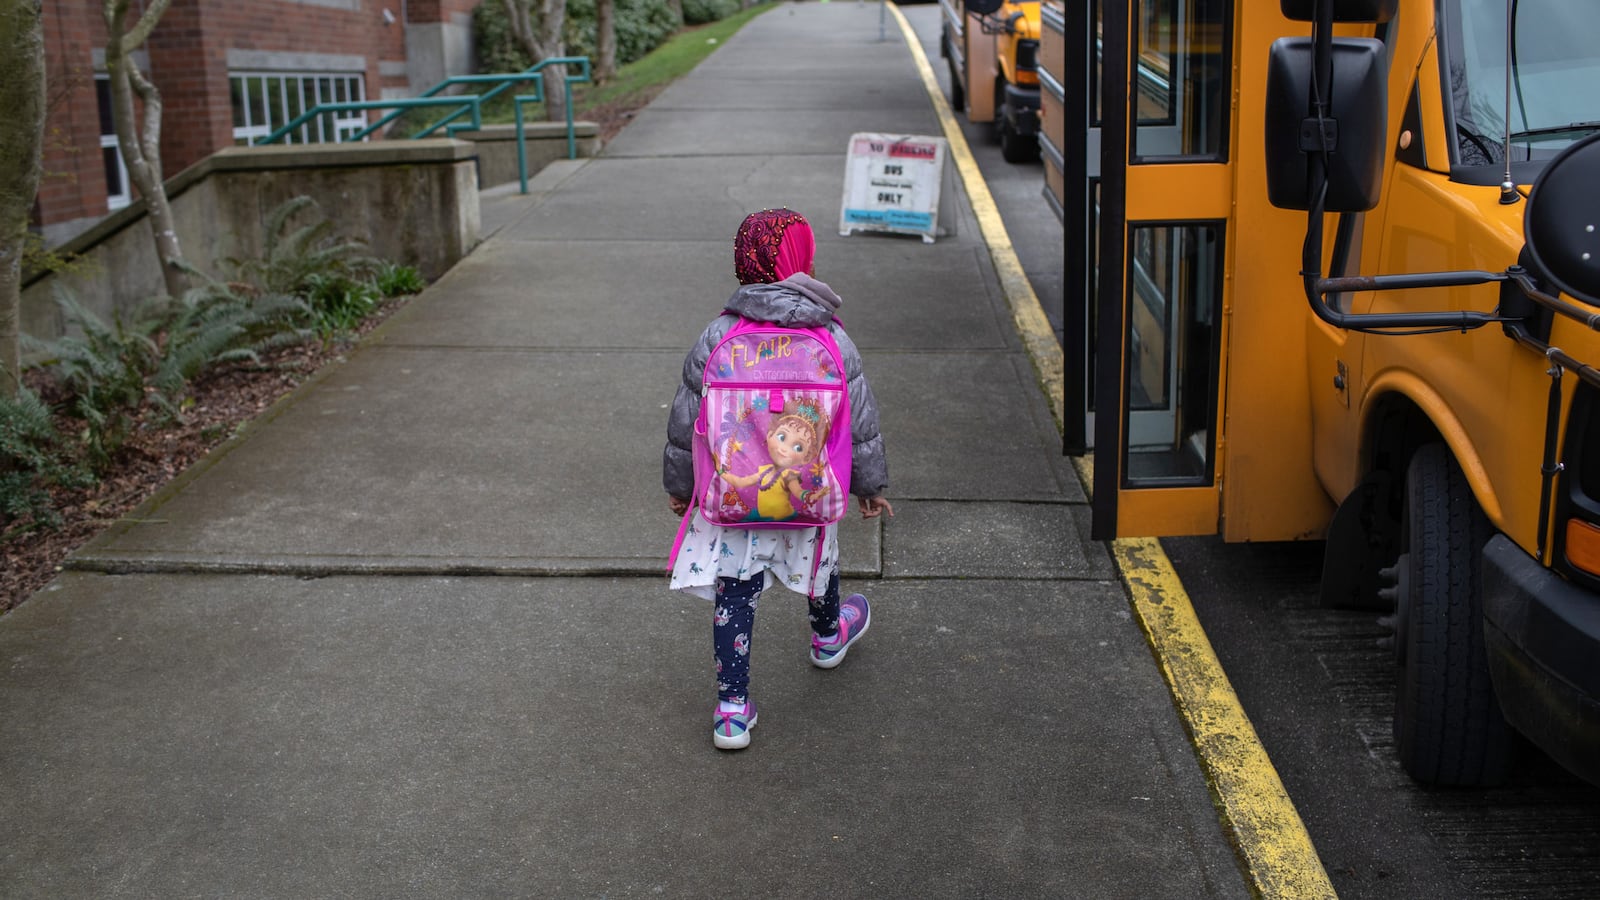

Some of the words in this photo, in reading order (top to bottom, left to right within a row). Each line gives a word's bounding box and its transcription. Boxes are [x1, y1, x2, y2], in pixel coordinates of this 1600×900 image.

[870, 143, 884, 152] NO
[892, 145, 935, 155] PARKING
[884, 165, 903, 176] BUS
[878, 193, 903, 204] ONLY
[731, 335, 792, 371] FLAIR
